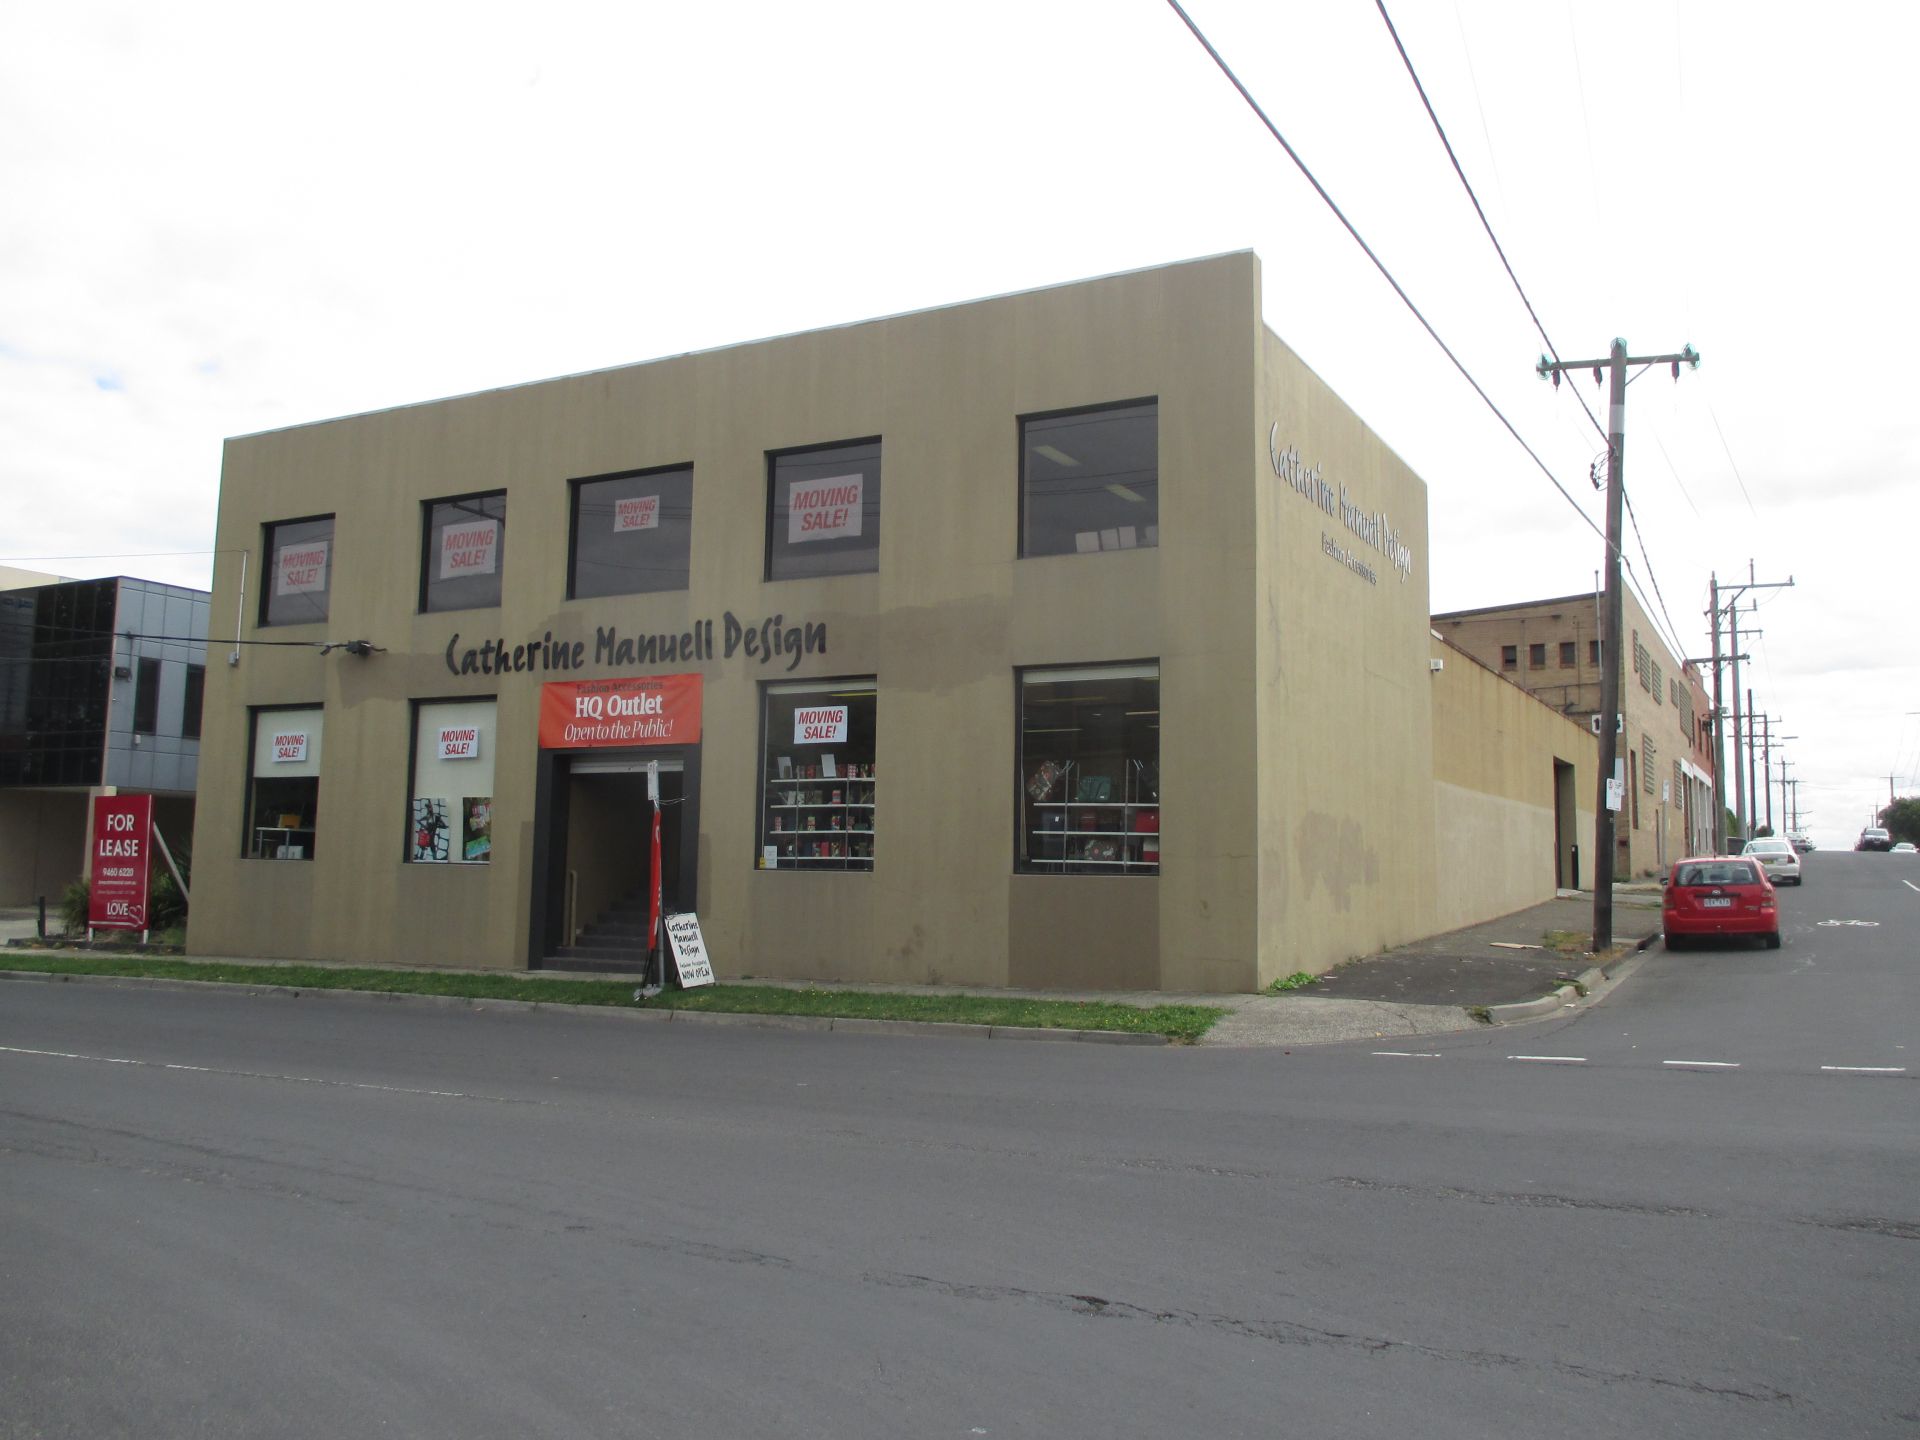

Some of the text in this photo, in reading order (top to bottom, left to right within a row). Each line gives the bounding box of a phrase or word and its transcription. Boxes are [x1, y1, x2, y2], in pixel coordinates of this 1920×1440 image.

[792, 485, 858, 511] MOVING
[617, 500, 656, 515] MOVING
[622, 512, 650, 528] SALE!
[800, 508, 849, 531] SALE!
[445, 528, 495, 551] MOVING
[281, 550, 325, 569] MOVING
[450, 550, 486, 569] SALE!
[286, 568, 318, 585] SALE!
[445, 611, 827, 675] Catherine Manuell Design
[575, 692, 663, 720] HQ Outlet
[798, 709, 844, 725] MOVING
[441, 729, 475, 742] MOVING
[564, 718, 674, 743] Open to the Public!
[803, 725, 837, 740] SALE!
[274, 734, 304, 746] MOVING
[277, 746, 300, 758] SALE!
[444, 743, 470, 755] SALE!
[106, 814, 135, 832] FOR
[99, 839, 139, 857] LEASE
[106, 902, 129, 916] LOVE
[667, 920, 699, 932] Catherine
[681, 966, 710, 980] NOW OPEN
